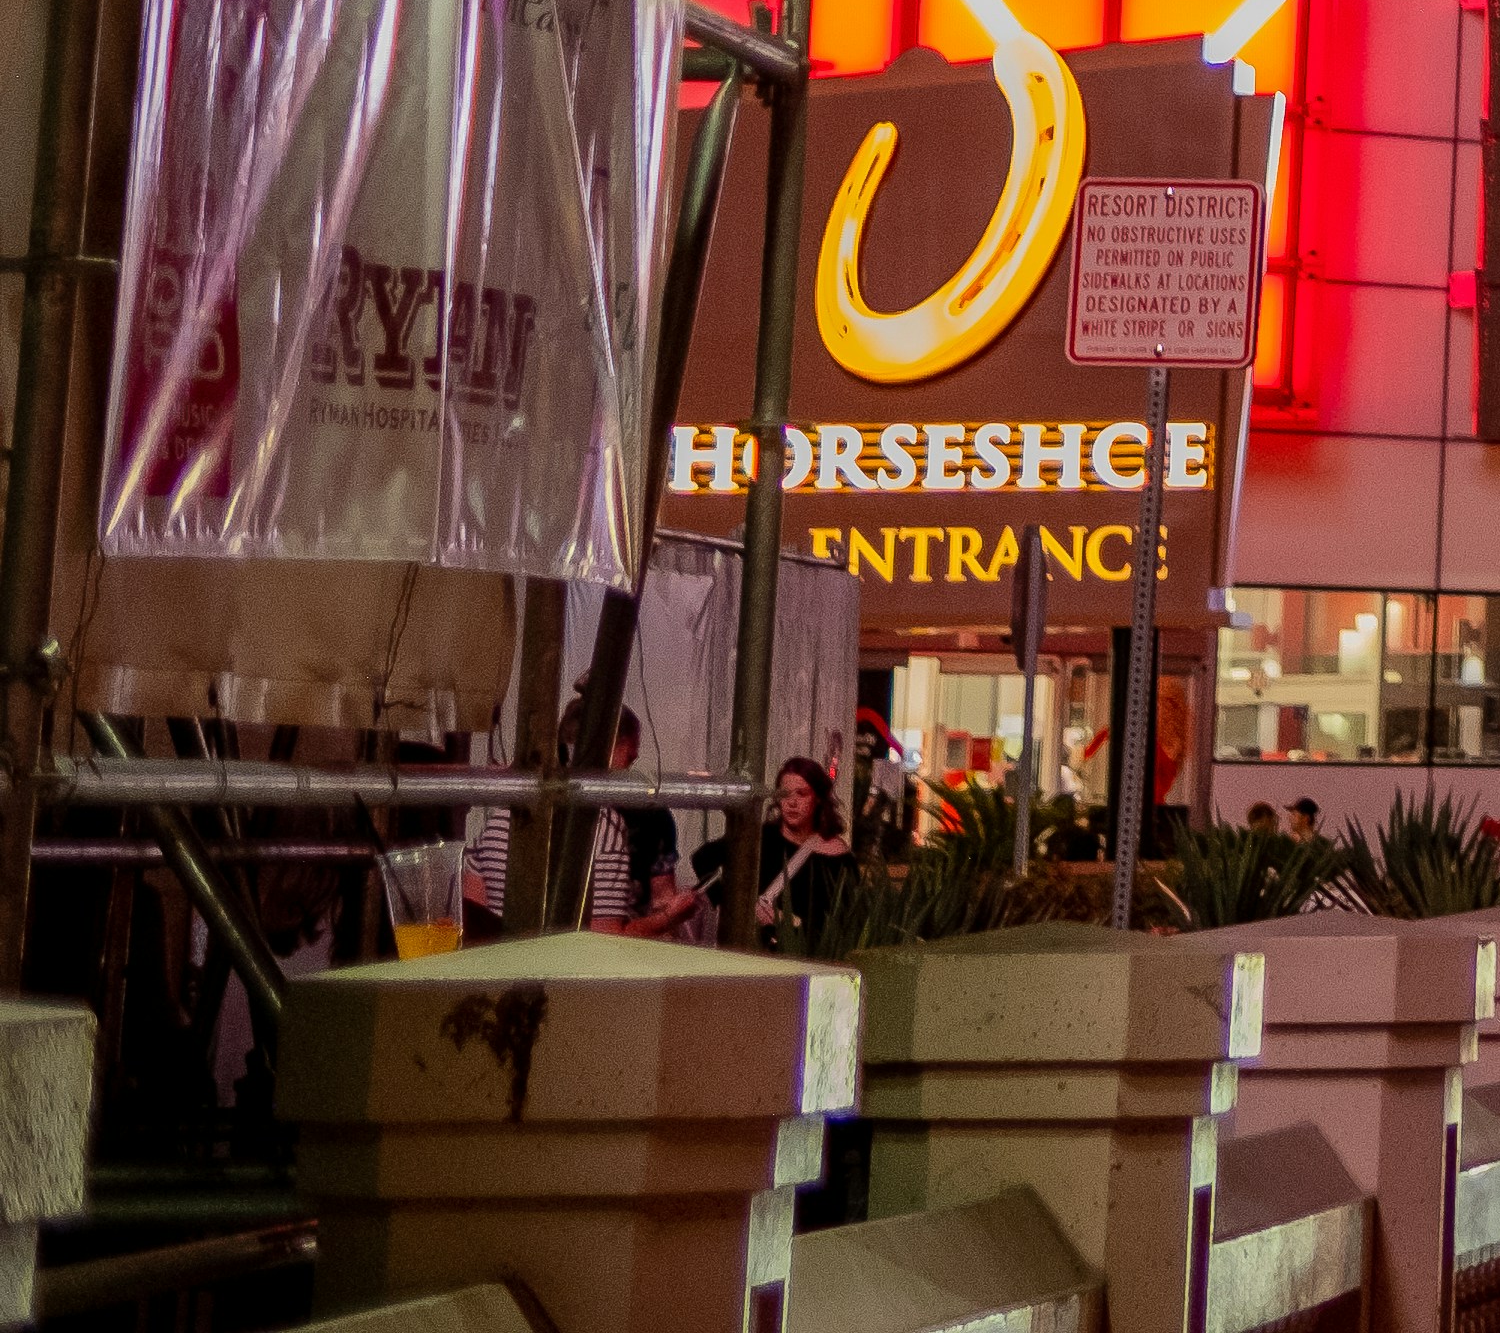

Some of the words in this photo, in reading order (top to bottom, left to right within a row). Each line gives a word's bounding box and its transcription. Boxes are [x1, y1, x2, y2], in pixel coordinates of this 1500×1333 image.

[1087, 194, 1157, 217] RESORT
[1087, 225, 1106, 242] NO
[1111, 225, 1204, 244] OBSTRUCTIVE
[1210, 227, 1247, 245] USES
[1096, 249, 1161, 267] PERMITTED
[1167, 250, 1184, 267] ON
[1190, 250, 1235, 268] PUBLIC
[1082, 272, 1150, 290] SIDEWALKS
[1156, 273, 1170, 290] AT
[1178, 274, 1246, 292] LOCATIONS
[1085, 296, 1191, 314] DESIGNATED
[1198, 297, 1220, 314] BY
[1227, 298, 1238, 315] A
[1081, 319, 1117, 337] WHITE
[1122, 320, 1166, 338] STRIPE
[1178, 320, 1195, 338] OR
[1206, 321, 1244, 339] SIGNS
